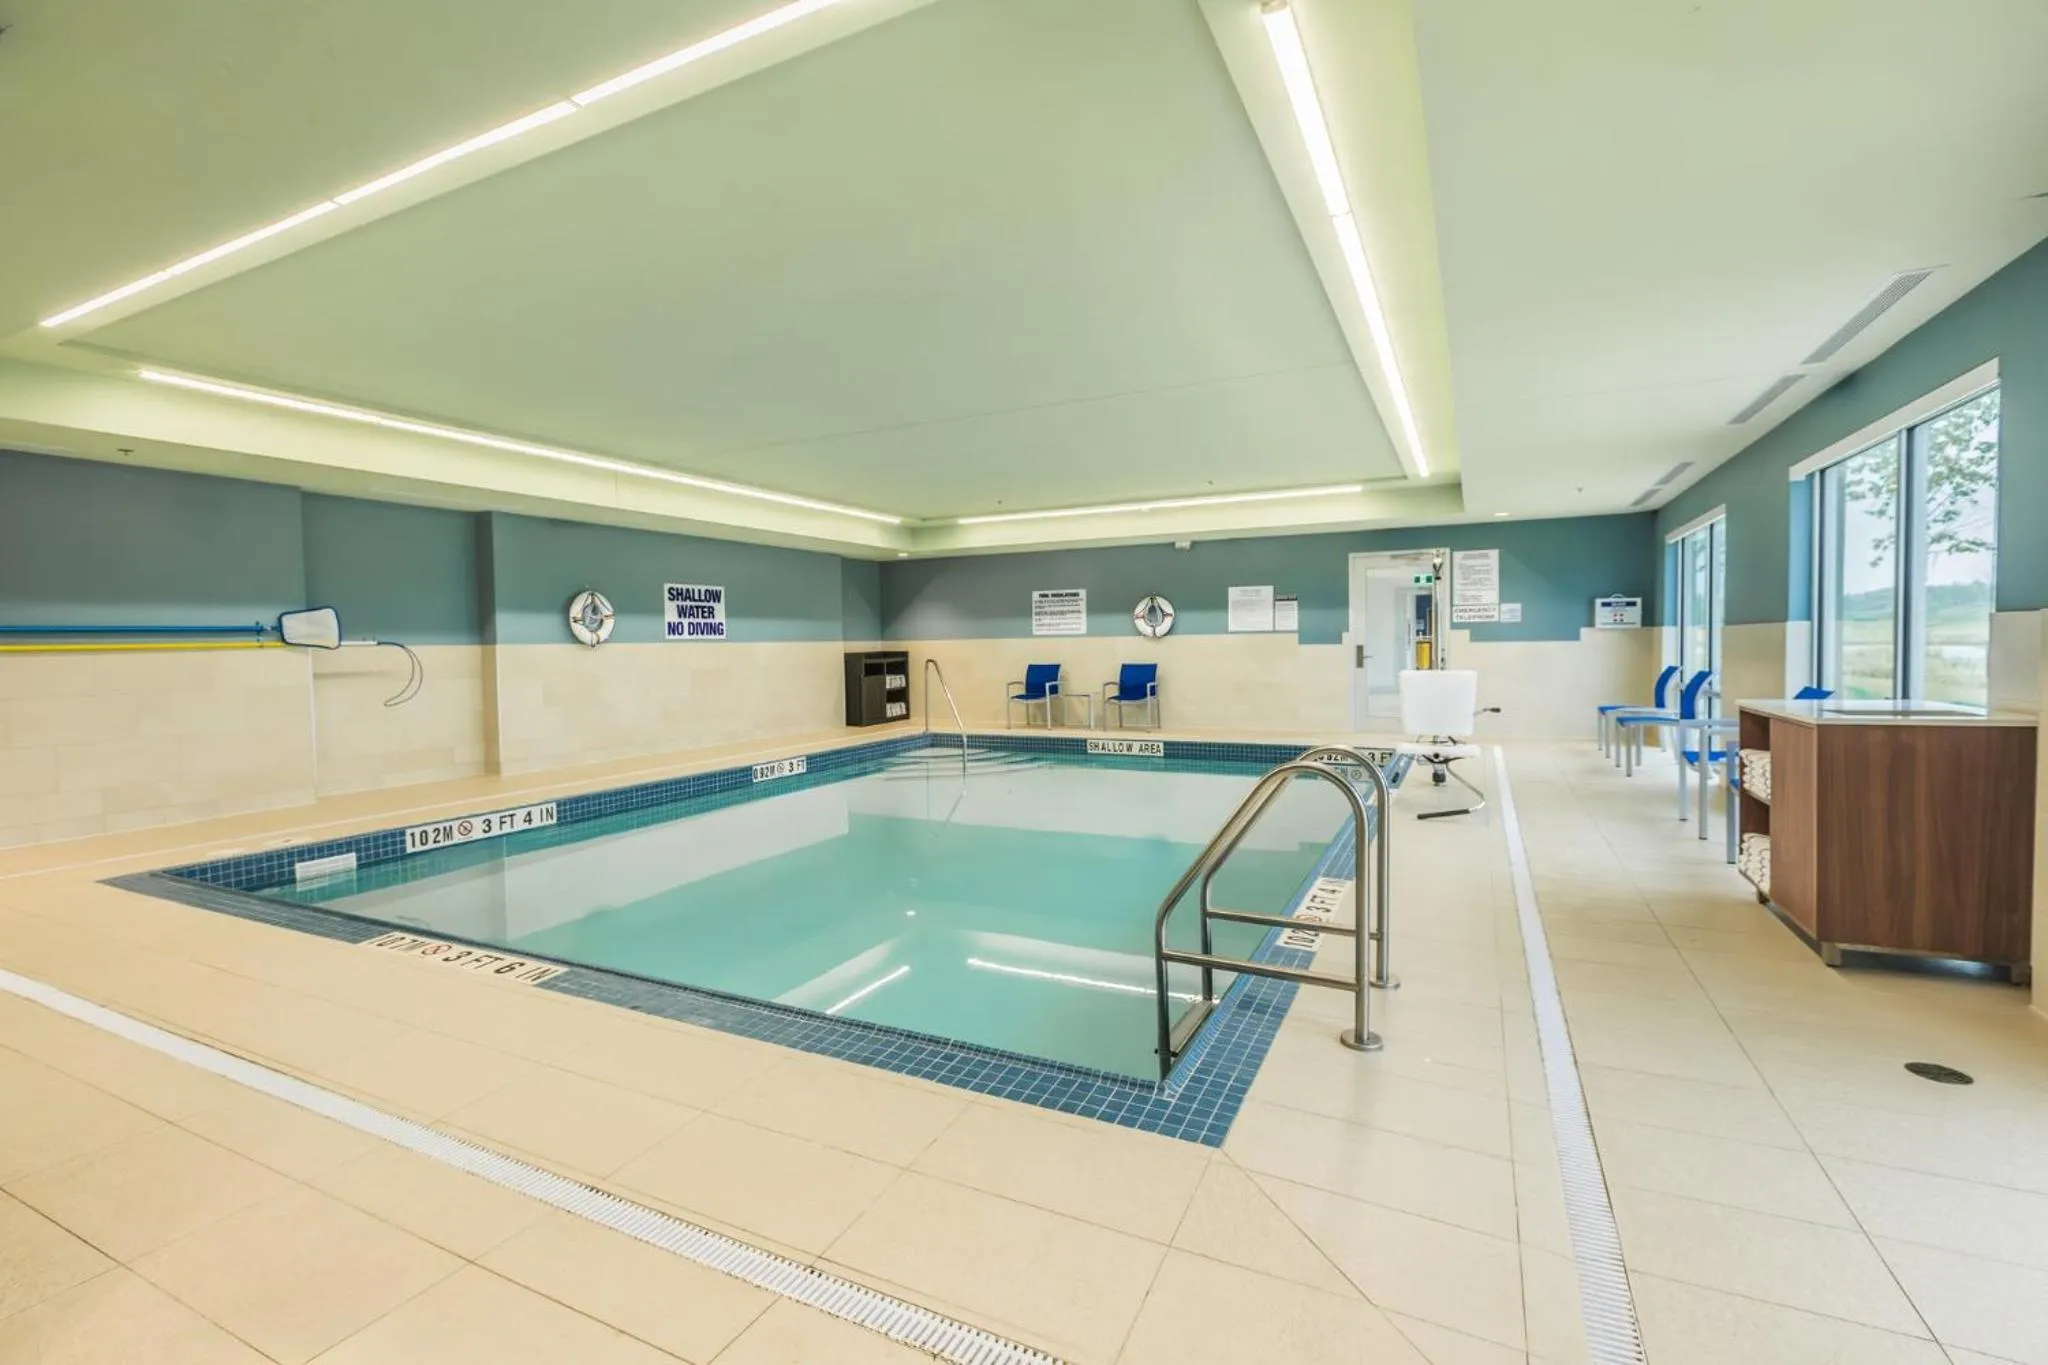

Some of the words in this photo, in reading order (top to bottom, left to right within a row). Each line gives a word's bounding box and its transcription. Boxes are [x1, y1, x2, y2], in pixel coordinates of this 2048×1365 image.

[668, 586, 721, 603] SHALLOW
[676, 605, 715, 619] WATER
[667, 621, 684, 636] NO
[688, 621, 724, 636] DIVING
[1089, 742, 1133, 752] SHALLOW
[1139, 743, 1161, 753] AREA
[788, 761, 794, 773] 3
[482, 818, 492, 834] 3
[499, 813, 516, 831] FT
[523, 810, 533, 825] 4
[540, 806, 554, 824] IN
[441, 951, 473, 962] 3
[460, 954, 504, 969] FT
[494, 961, 525, 974] 6
